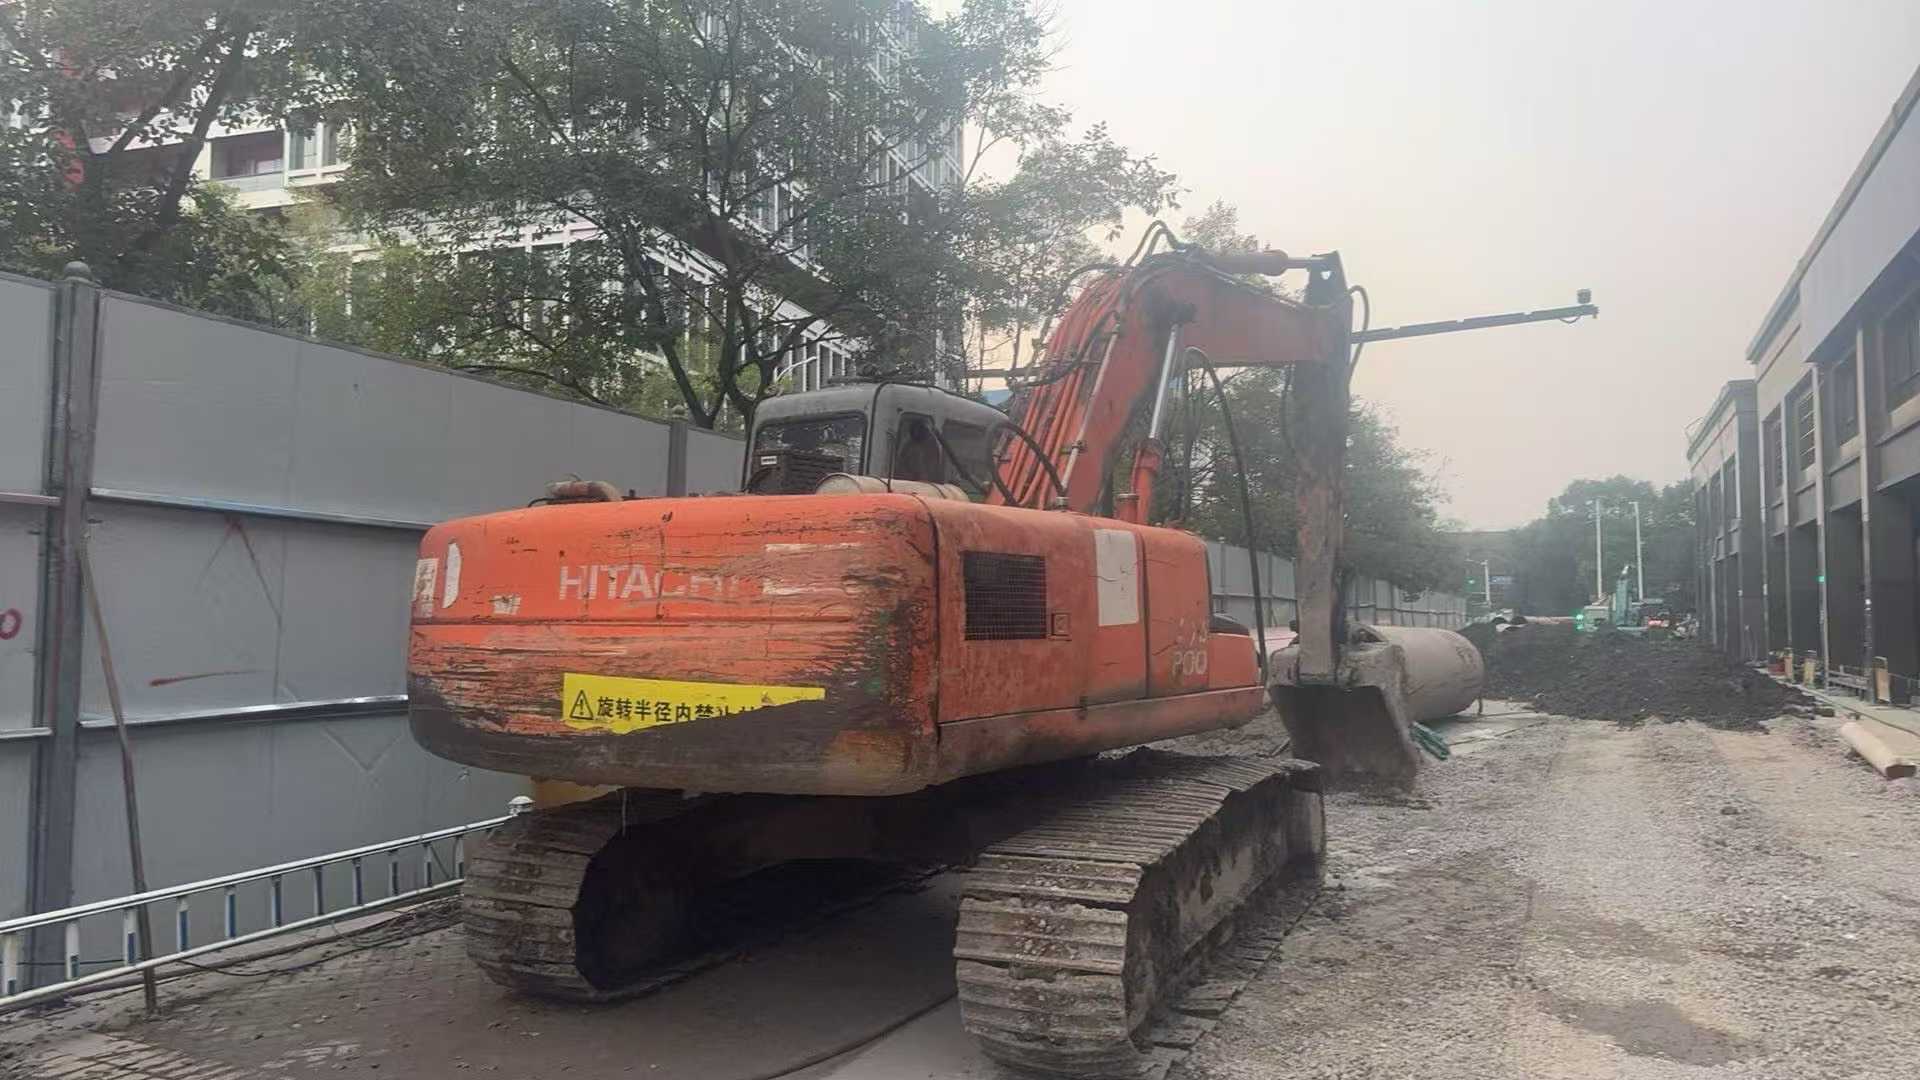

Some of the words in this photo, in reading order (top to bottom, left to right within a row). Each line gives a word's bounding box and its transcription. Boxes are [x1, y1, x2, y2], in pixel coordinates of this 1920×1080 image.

[597, 697, 754, 722] 旋转半径内禁
